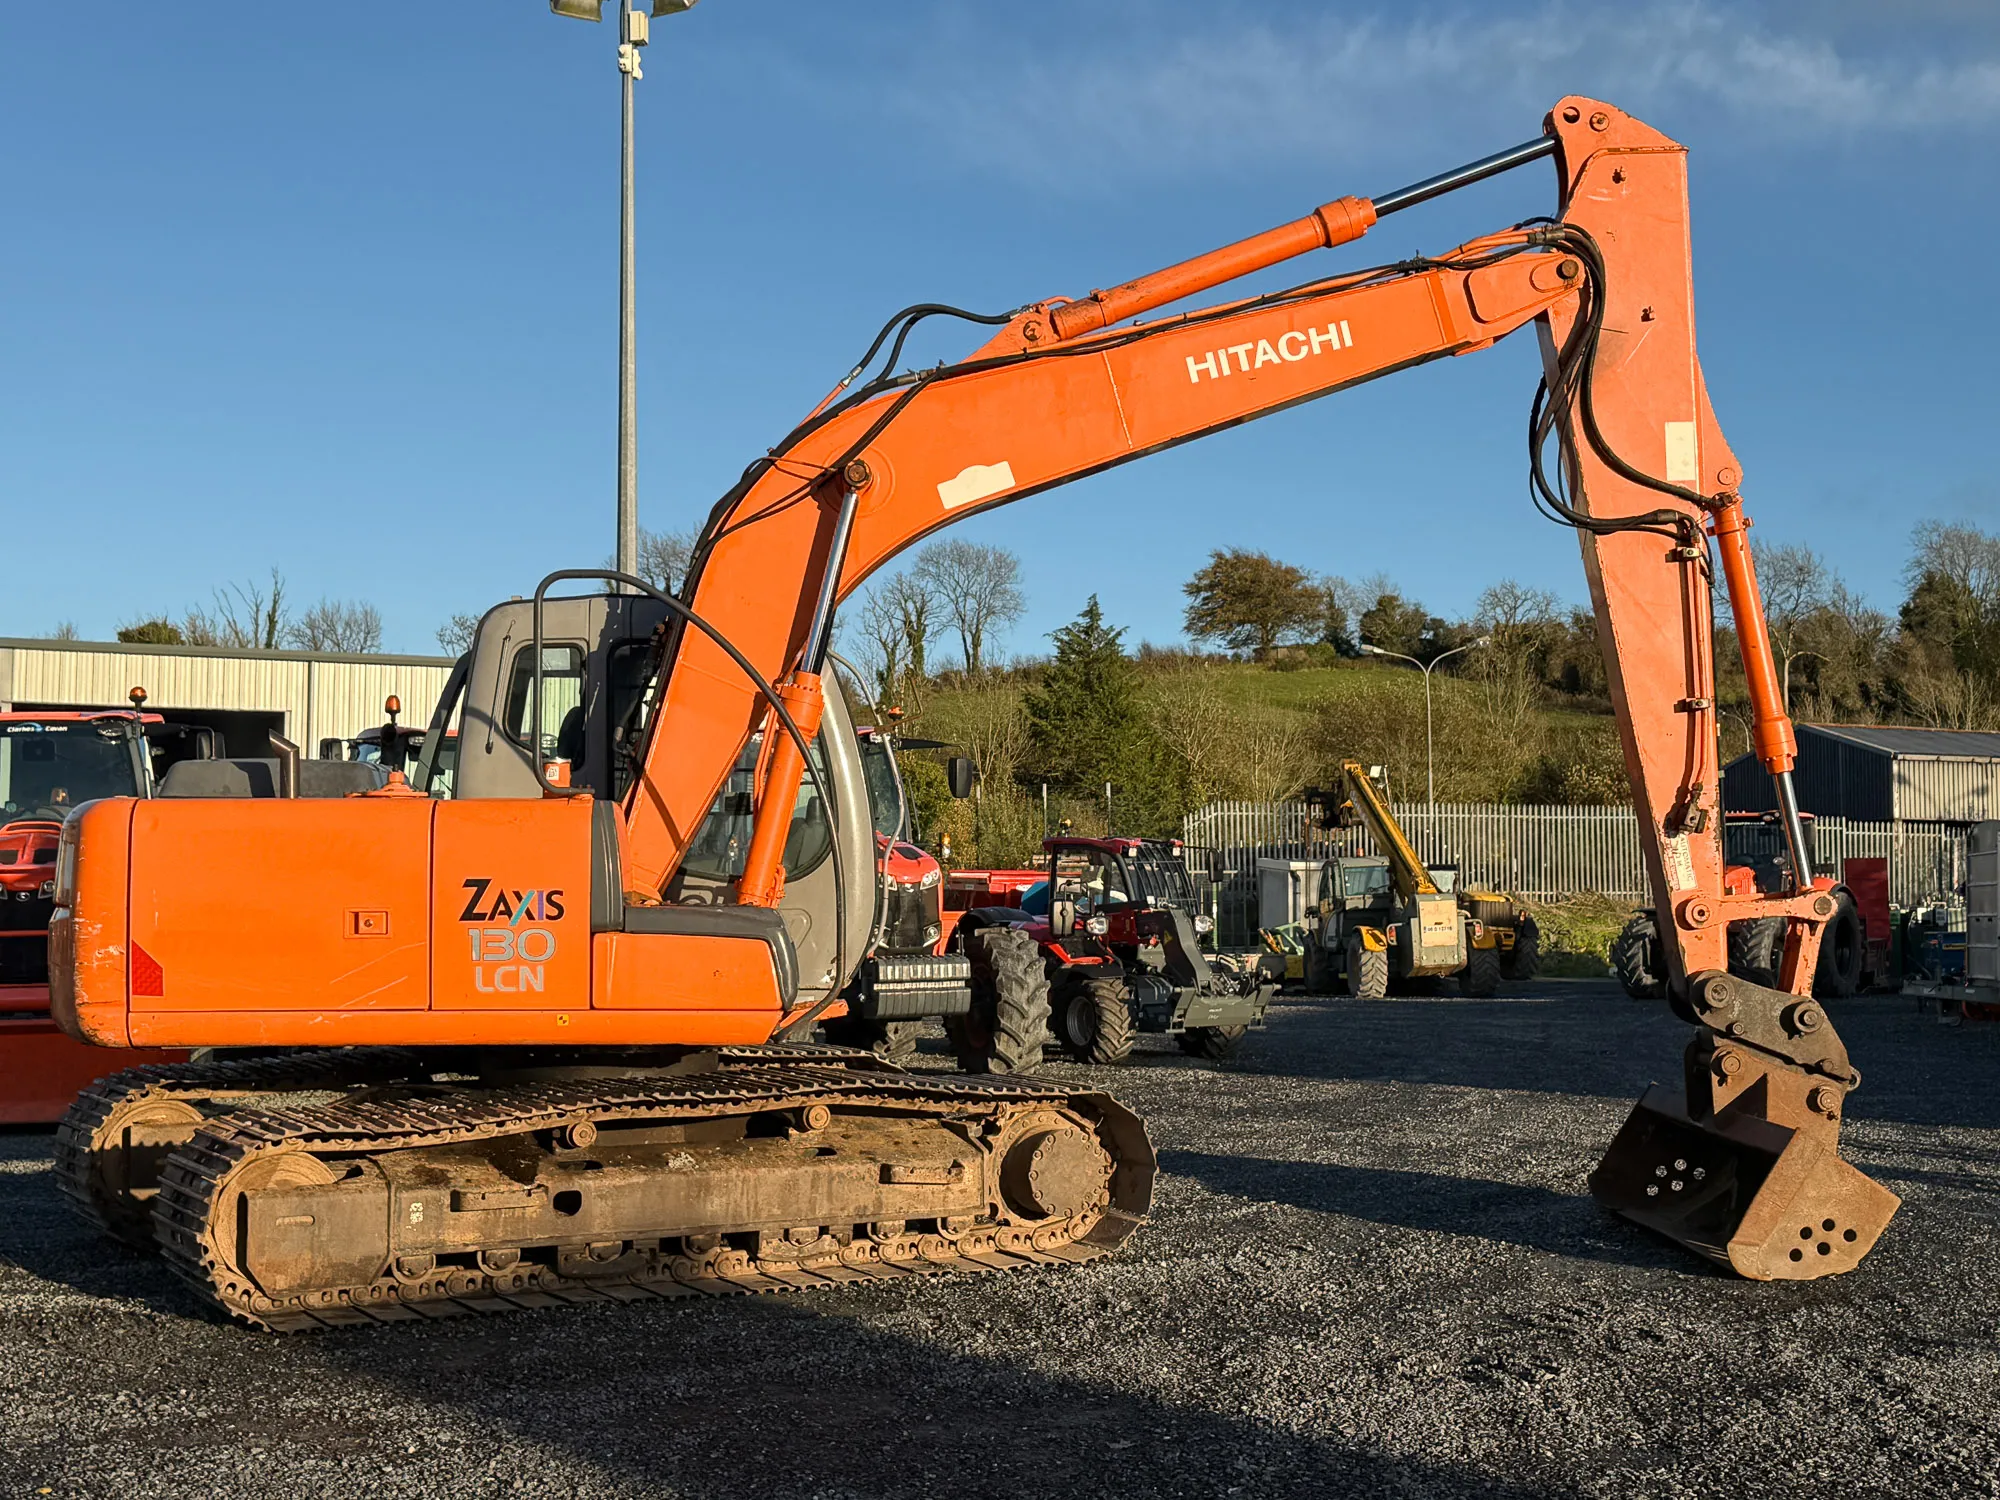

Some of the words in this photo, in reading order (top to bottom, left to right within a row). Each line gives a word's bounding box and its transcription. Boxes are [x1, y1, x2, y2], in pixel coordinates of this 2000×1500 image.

[1185, 319, 1353, 384] HITACHI
[1680, 837, 1694, 881] AUTOMATIC
[459, 879, 564, 926] ZAXIS
[468, 928, 556, 962] 130
[475, 966, 544, 992] LCN
